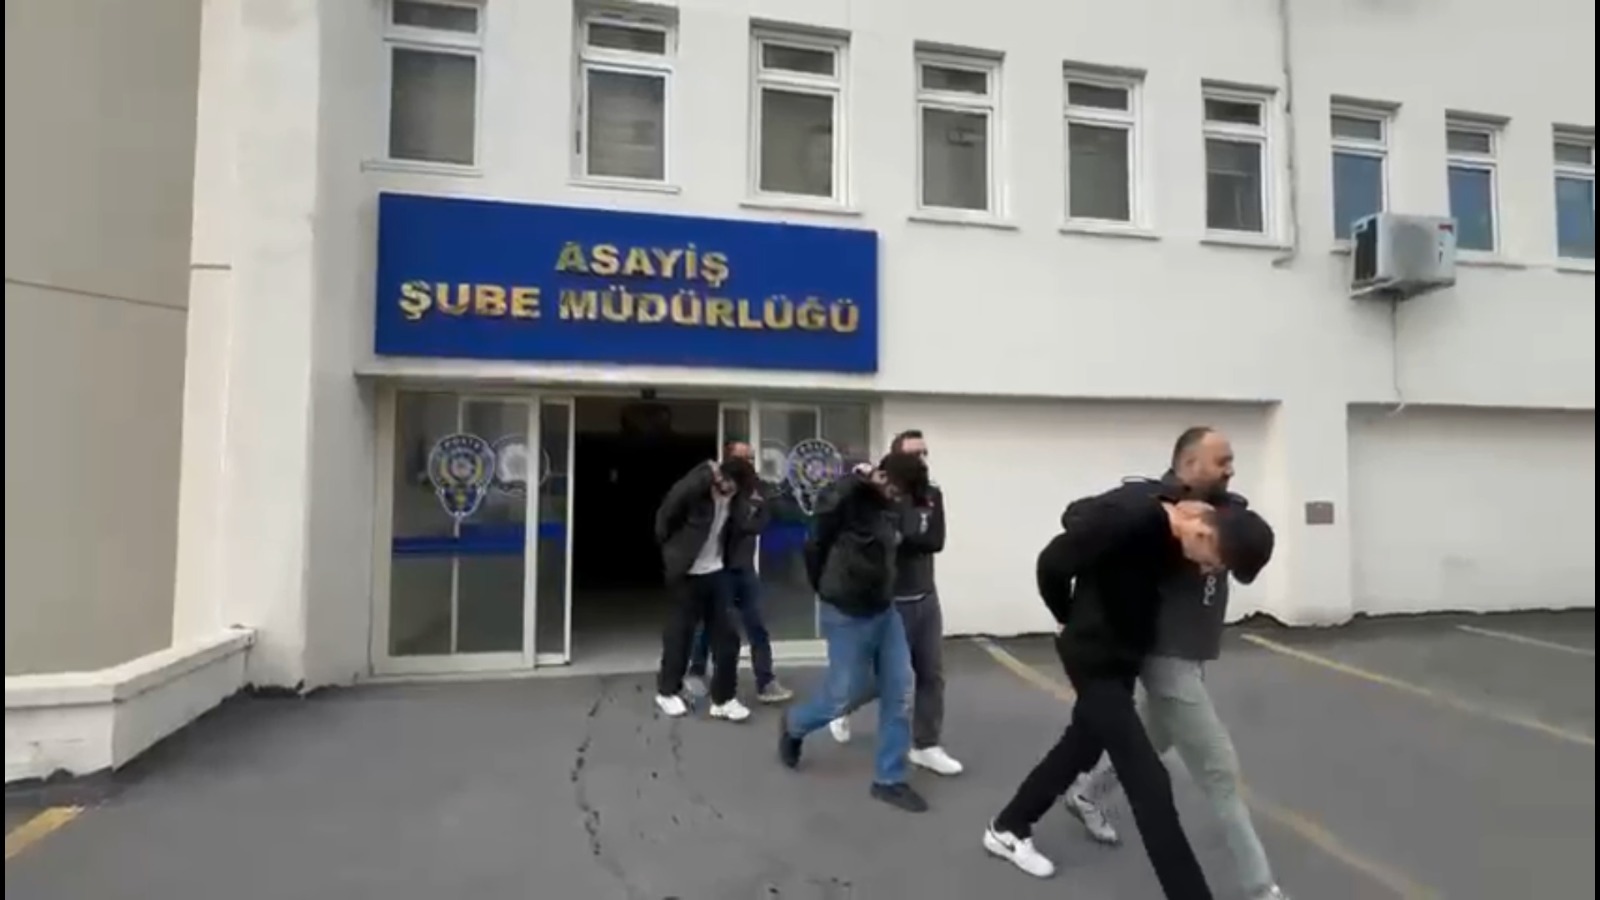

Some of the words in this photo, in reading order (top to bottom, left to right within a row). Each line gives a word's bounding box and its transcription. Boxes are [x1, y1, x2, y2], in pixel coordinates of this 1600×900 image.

[555, 241, 729, 287] ASAYİŞ
[399, 280, 541, 320] ŞUBE
[559, 285, 860, 333] MÜDÜRLÜĞÜ
